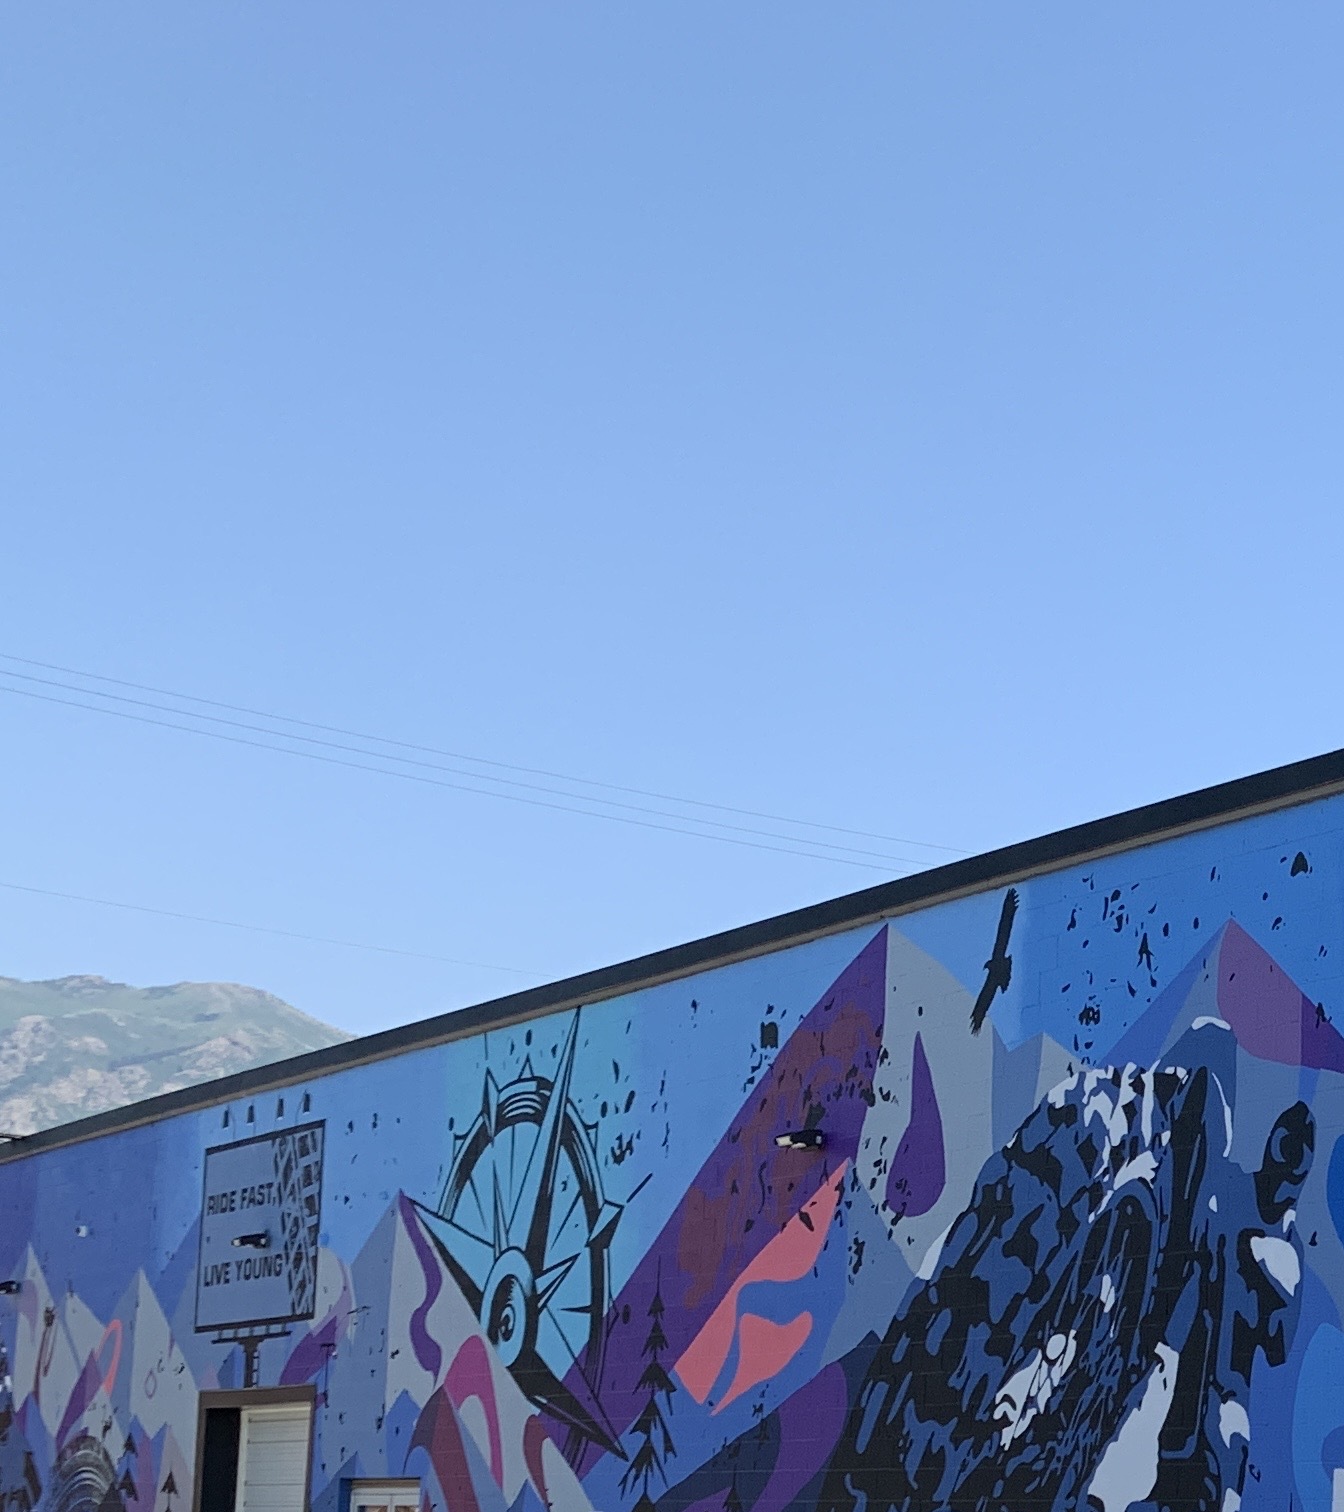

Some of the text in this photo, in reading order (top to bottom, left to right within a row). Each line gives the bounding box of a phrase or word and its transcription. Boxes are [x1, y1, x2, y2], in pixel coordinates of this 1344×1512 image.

[206, 1190, 236, 1216] RIDE
[204, 1253, 283, 1287] LIVE YOUNG
